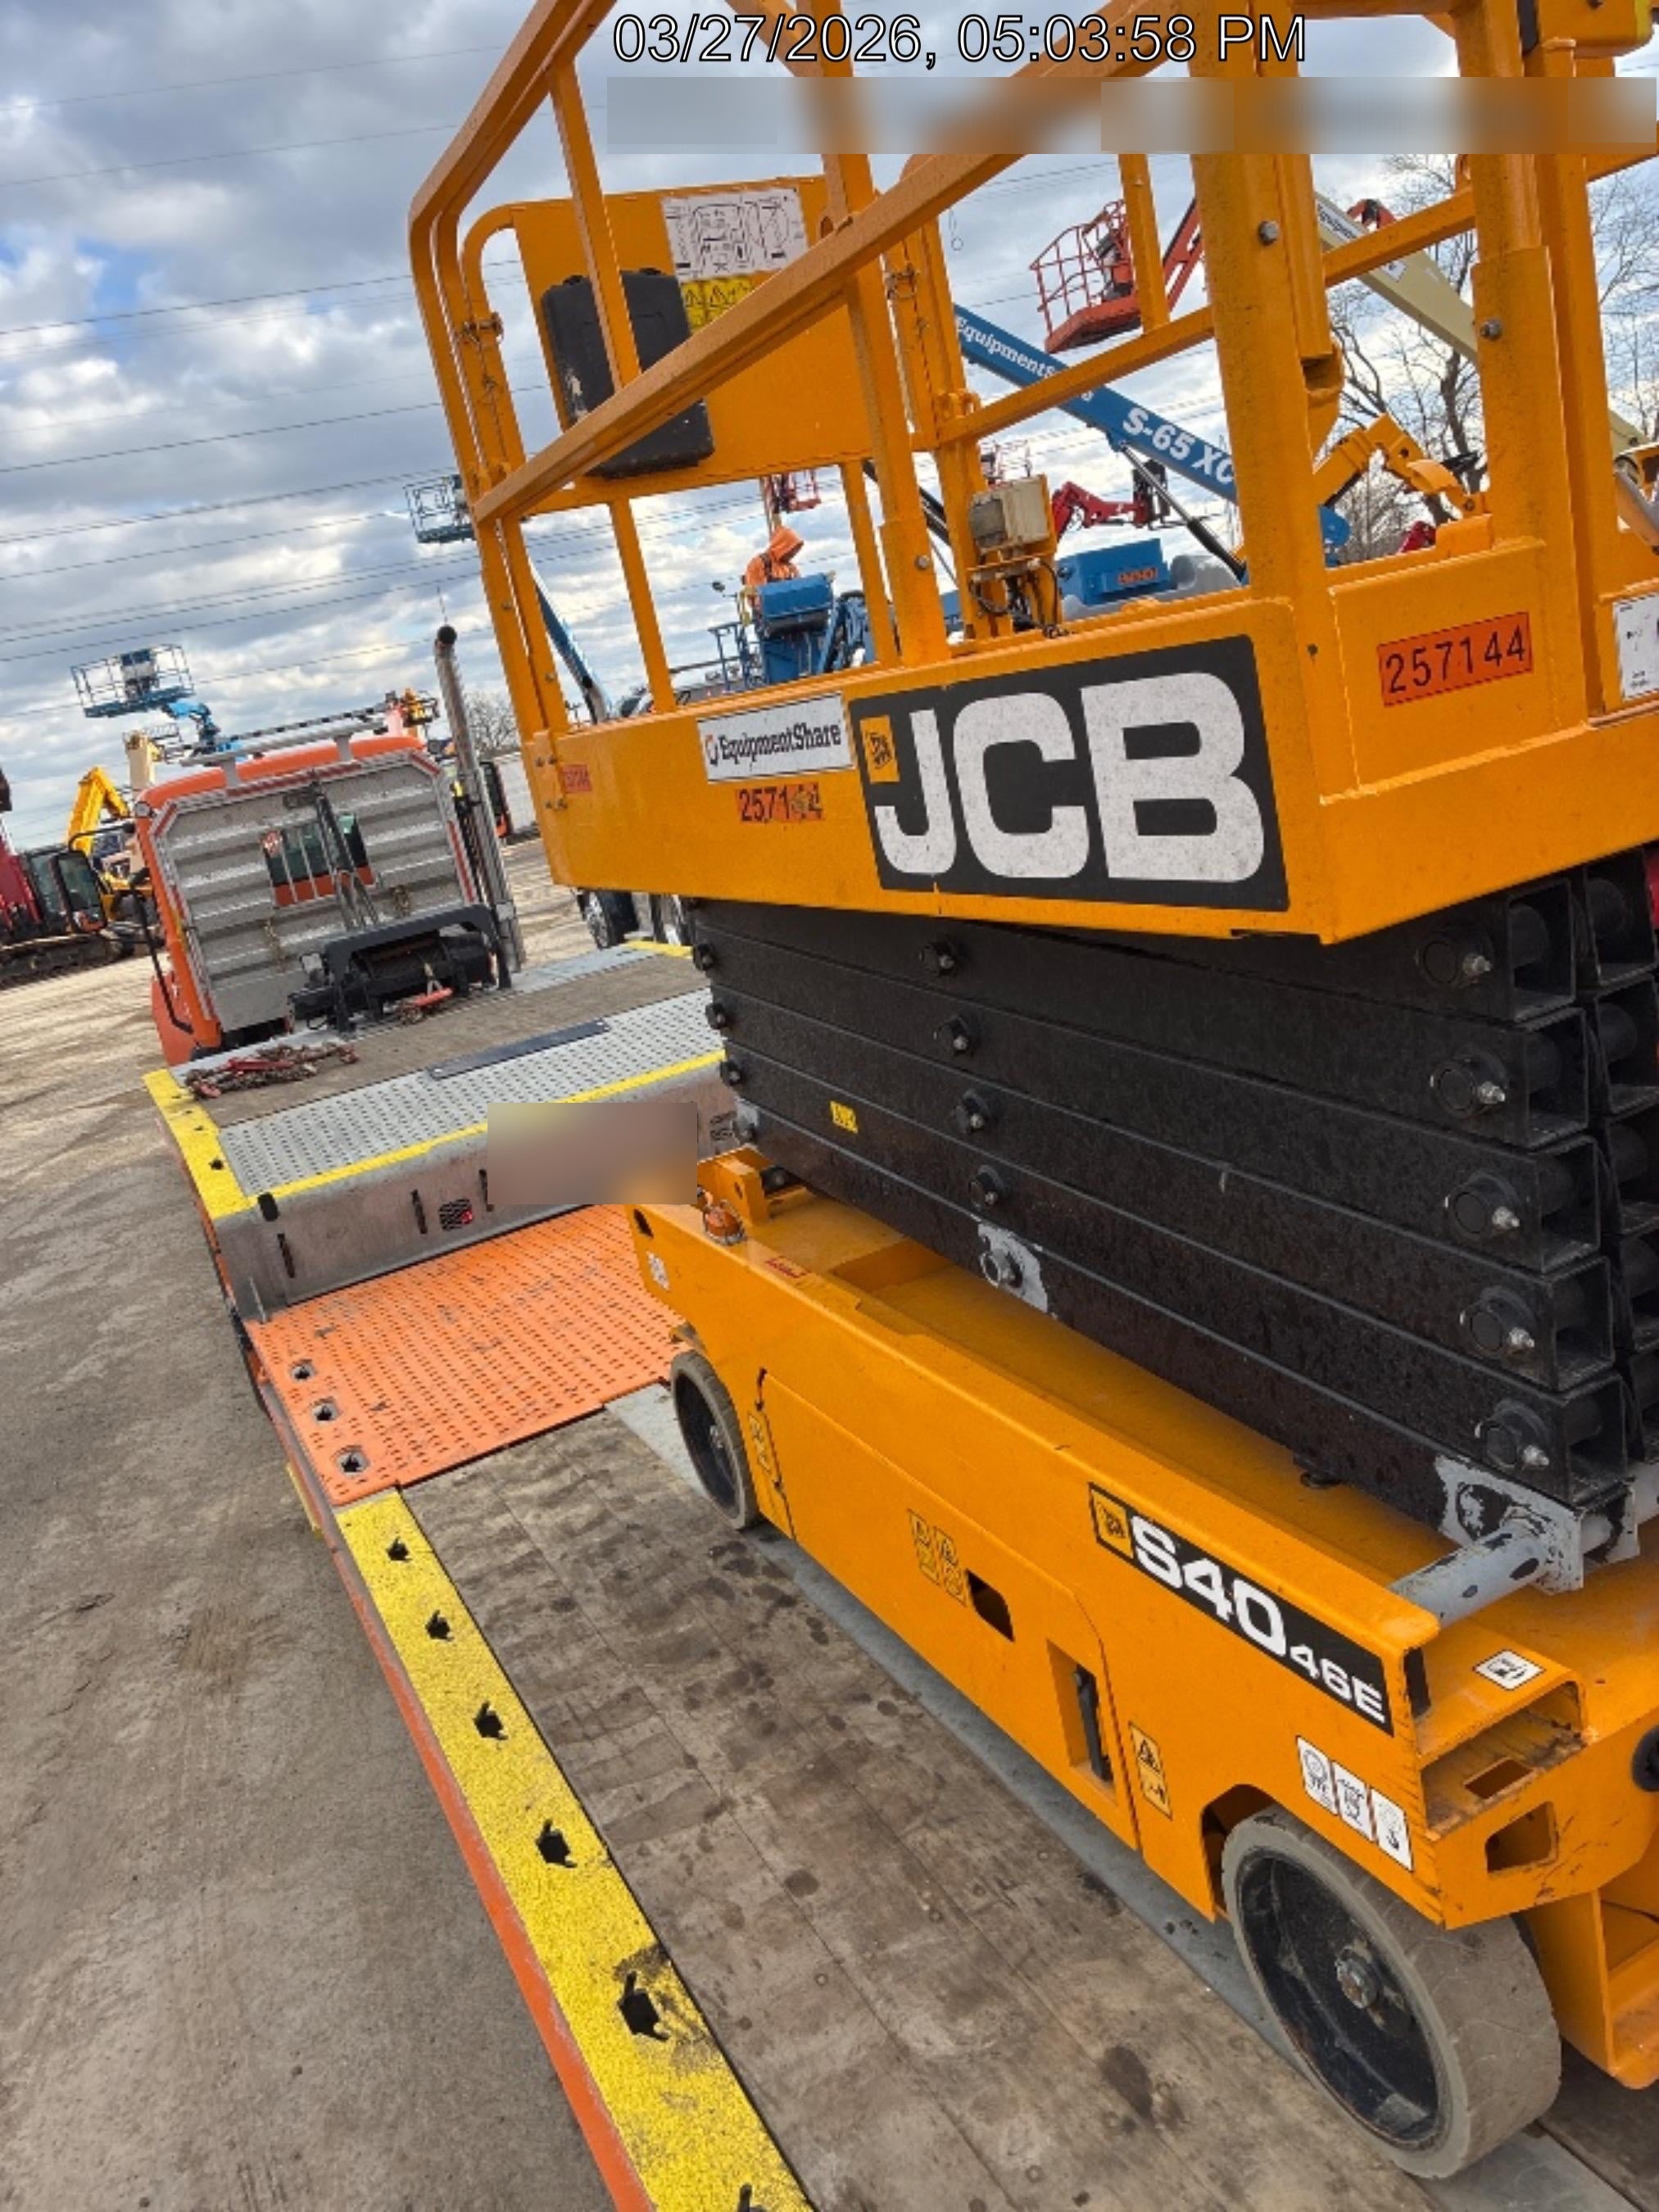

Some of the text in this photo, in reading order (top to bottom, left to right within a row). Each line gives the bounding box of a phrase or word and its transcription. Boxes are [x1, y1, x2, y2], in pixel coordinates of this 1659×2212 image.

[1122, 407, 1196, 460] S-65
[1385, 625, 1525, 694] 257144
[718, 723, 841, 765] EquipmentShare
[874, 672, 1265, 882] JCB
